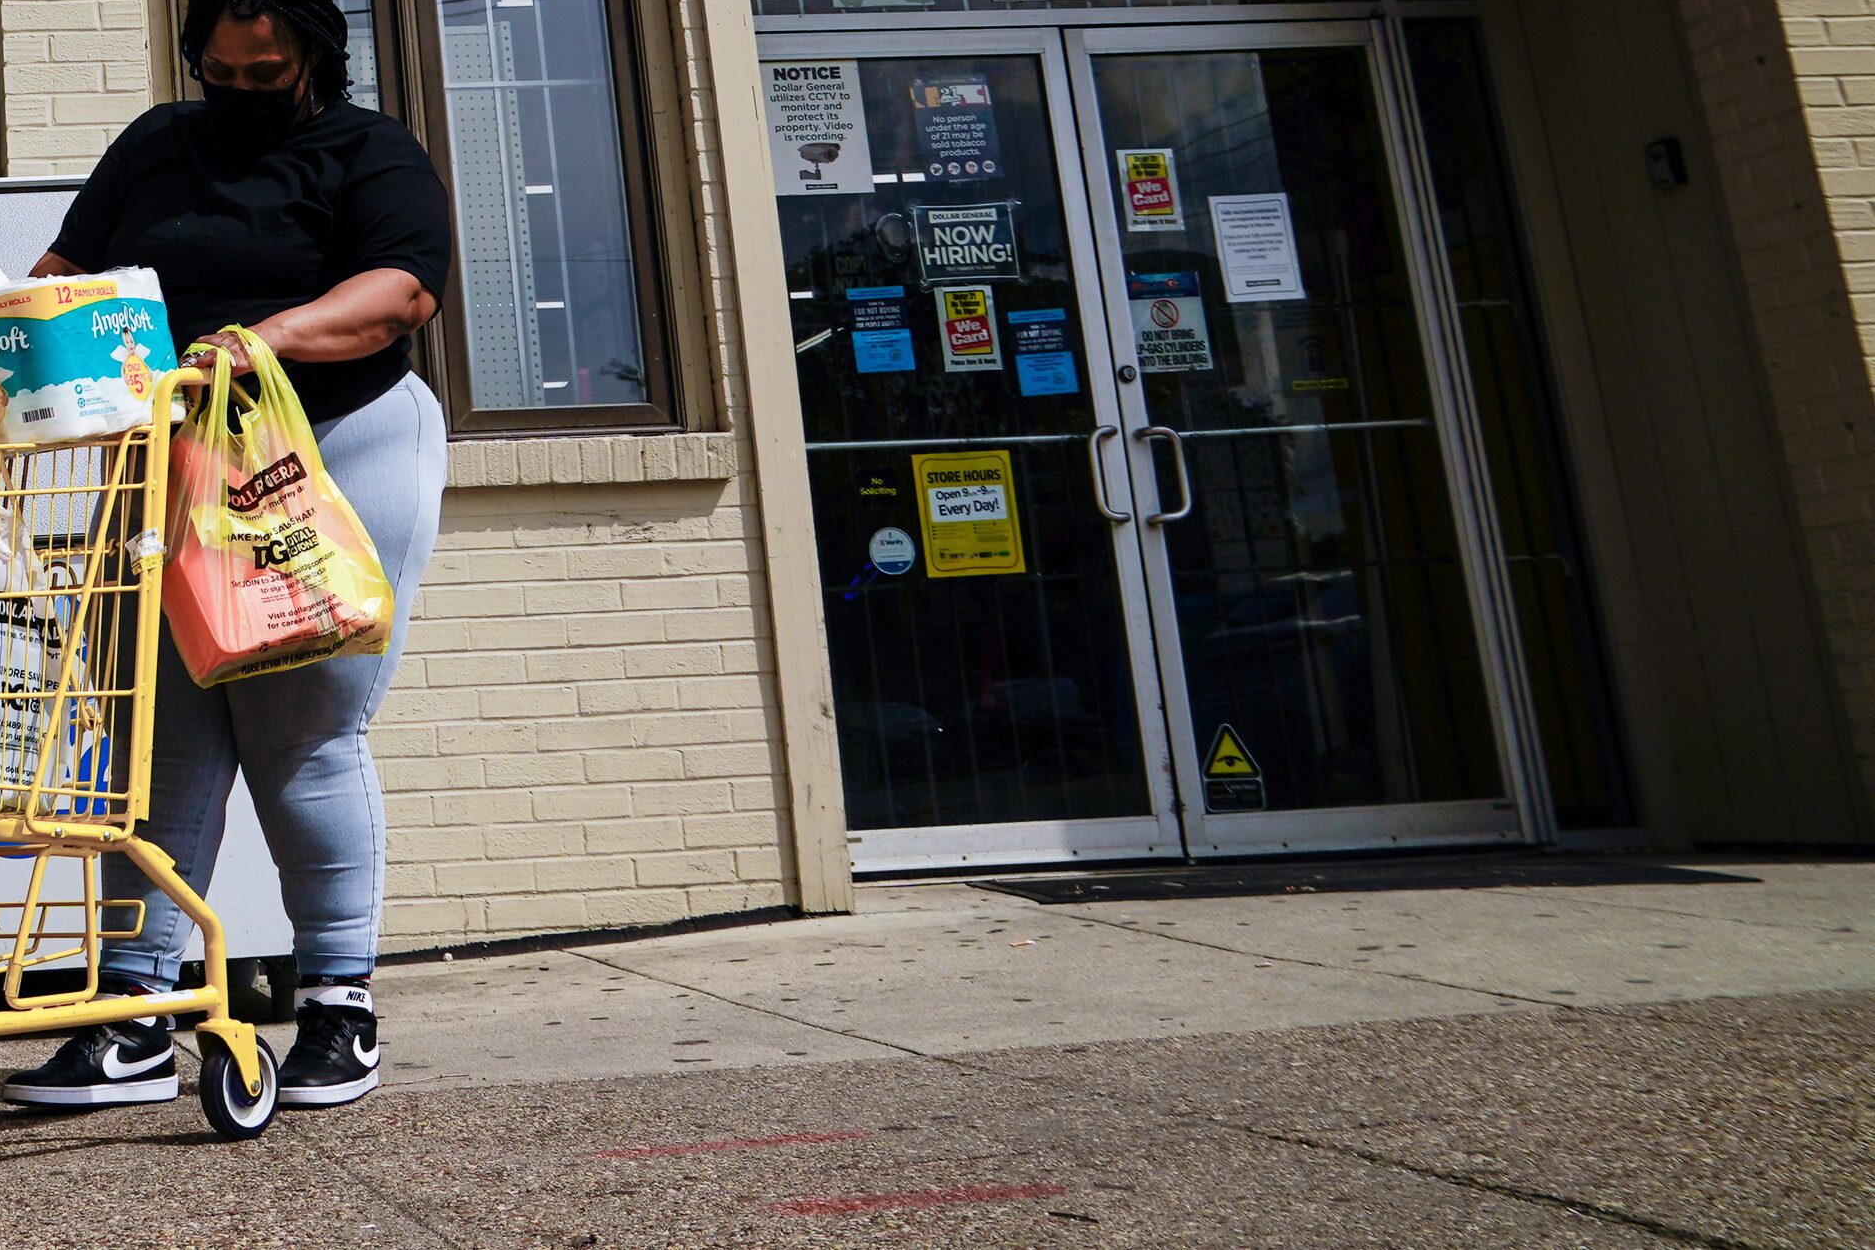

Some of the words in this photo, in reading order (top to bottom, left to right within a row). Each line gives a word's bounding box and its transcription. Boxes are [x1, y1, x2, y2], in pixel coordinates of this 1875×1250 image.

[773, 66, 842, 81] NOTICE
[773, 83, 803, 92] Dollar
[806, 82, 844, 91] General
[770, 93, 805, 102] utilizes
[808, 92, 836, 101] CCTV
[840, 92, 850, 100] to
[781, 103, 820, 111] monitor
[823, 102, 842, 110] and
[787, 113, 824, 122] protect
[827, 112, 839, 120] its
[947, 115, 976, 124] person
[775, 123, 821, 133] property.
[824, 122, 853, 130] Video
[970, 123, 986, 131] age
[784, 133, 792, 141] is
[795, 132, 847, 141] recording.
[952, 132, 971, 140] may
[931, 141, 950, 149] sold
[951, 140, 986, 148] tobacco
[940, 149, 981, 158] products.
[1135, 181, 1163, 194] We
[1132, 190, 1171, 206] Card
[933, 213, 960, 221] DOLLAR
[961, 211, 994, 219] GENERAL
[933, 225, 995, 246] NOW
[923, 243, 1013, 266] HIRING!
[54, 285, 73, 304] 12
[74, 288, 97, 299] FAMILY
[96, 286, 115, 297] ROLLS
[8, 295, 32, 308] ROLLS
[91, 307, 128, 338] Angel
[126, 310, 155, 333] Soft
[953, 319, 981, 333] We
[951, 329, 990, 346] Card
[1141, 330, 1154, 342] DO
[1154, 329, 1170, 341] NOT
[1170, 328, 1196, 341] BRING
[1164, 340, 1206, 354] CYLINDERS
[1157, 354, 1172, 366] THE
[1172, 353, 1208, 366] BUILDING
[870, 477, 883, 485] No
[927, 471, 962, 484] STORE
[963, 468, 1001, 482] HOURS
[860, 487, 897, 496] Soliciting
[935, 489, 961, 501] Open
[938, 503, 971, 517] Every
[973, 497, 1000, 513] Day!
[252, 540, 291, 570] DG
[242, 579, 260, 588] JOIN
[267, 611, 286, 620] Visit
[267, 622, 279, 630] for
[281, 615, 306, 627] career
[346, 989, 367, 1004] NIKE
